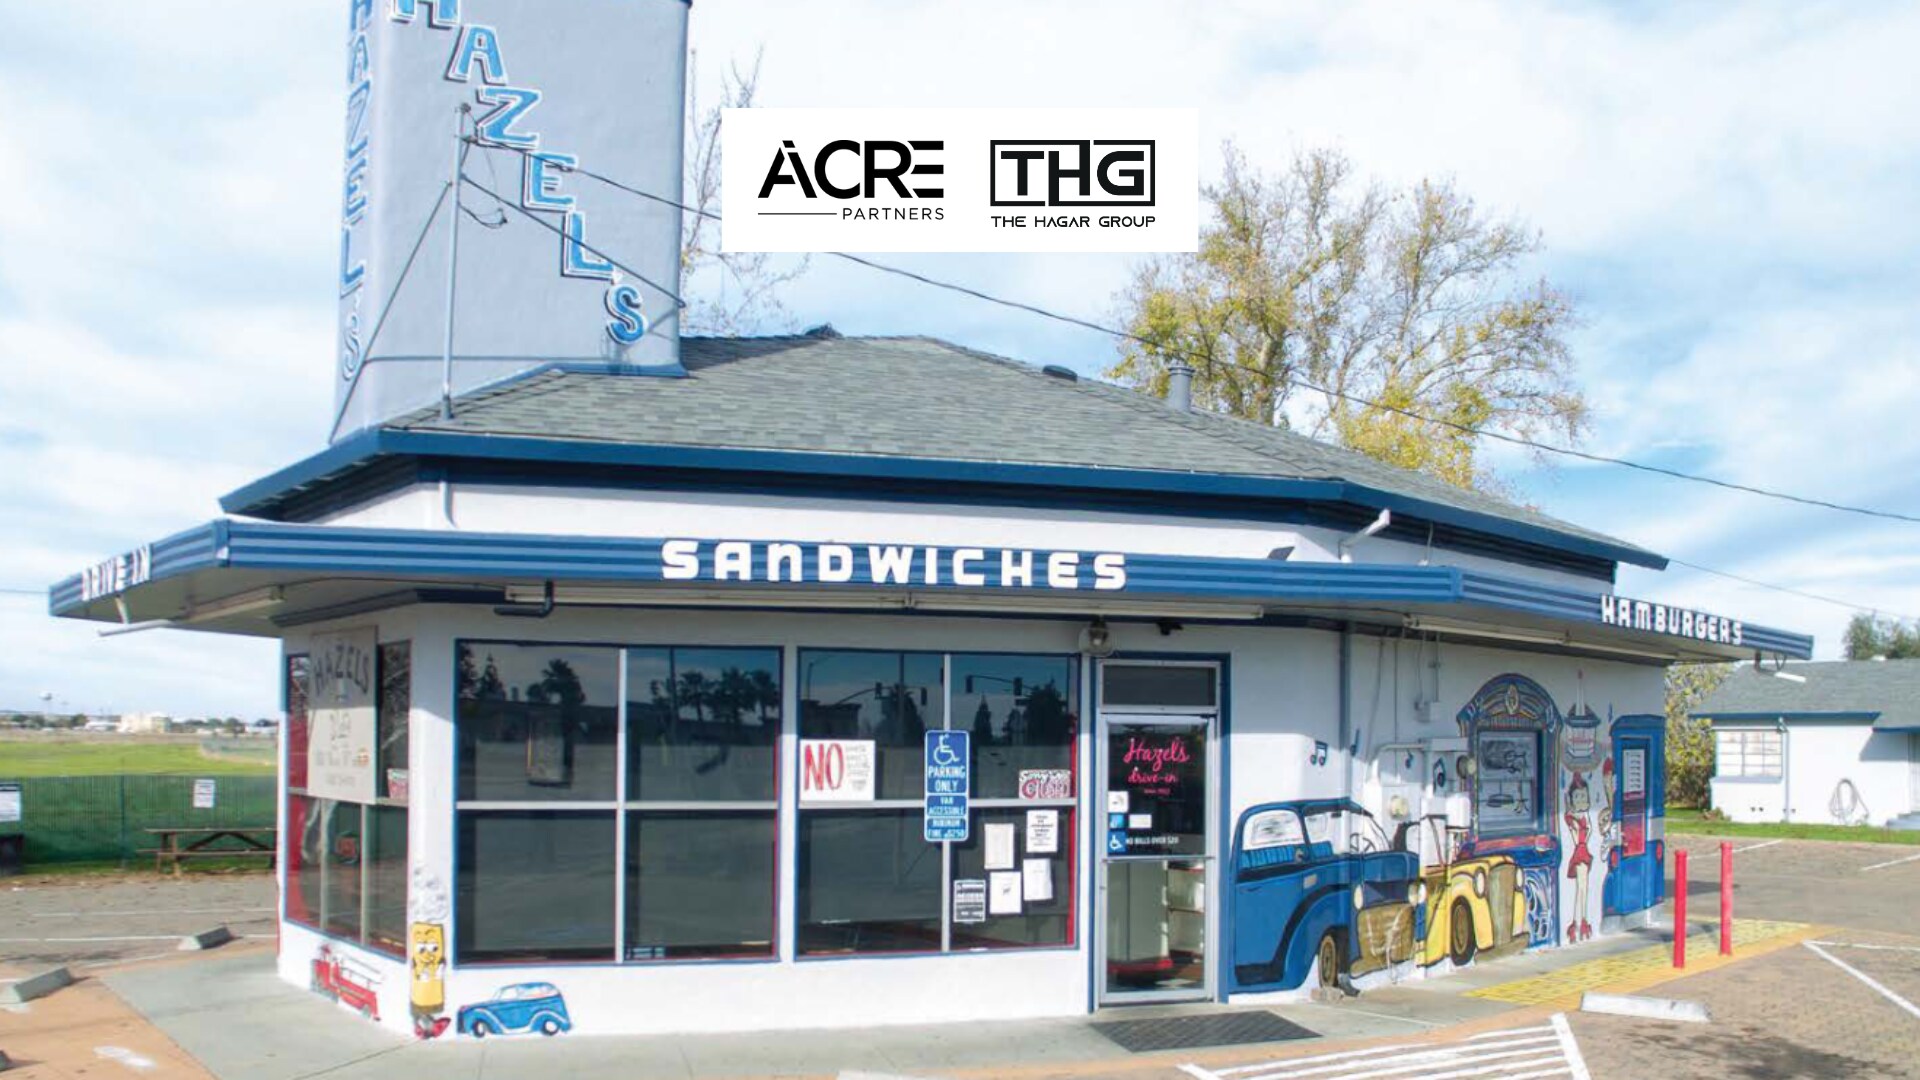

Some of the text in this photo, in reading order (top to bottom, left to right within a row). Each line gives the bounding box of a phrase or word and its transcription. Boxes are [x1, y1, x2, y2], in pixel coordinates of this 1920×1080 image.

[661, 539, 1127, 590] SANDWICHES
[1602, 594, 1742, 645] HAMBURGERS
[804, 743, 844, 791] NO
[928, 766, 966, 779] PARKING
[935, 780, 959, 793] ONLY
